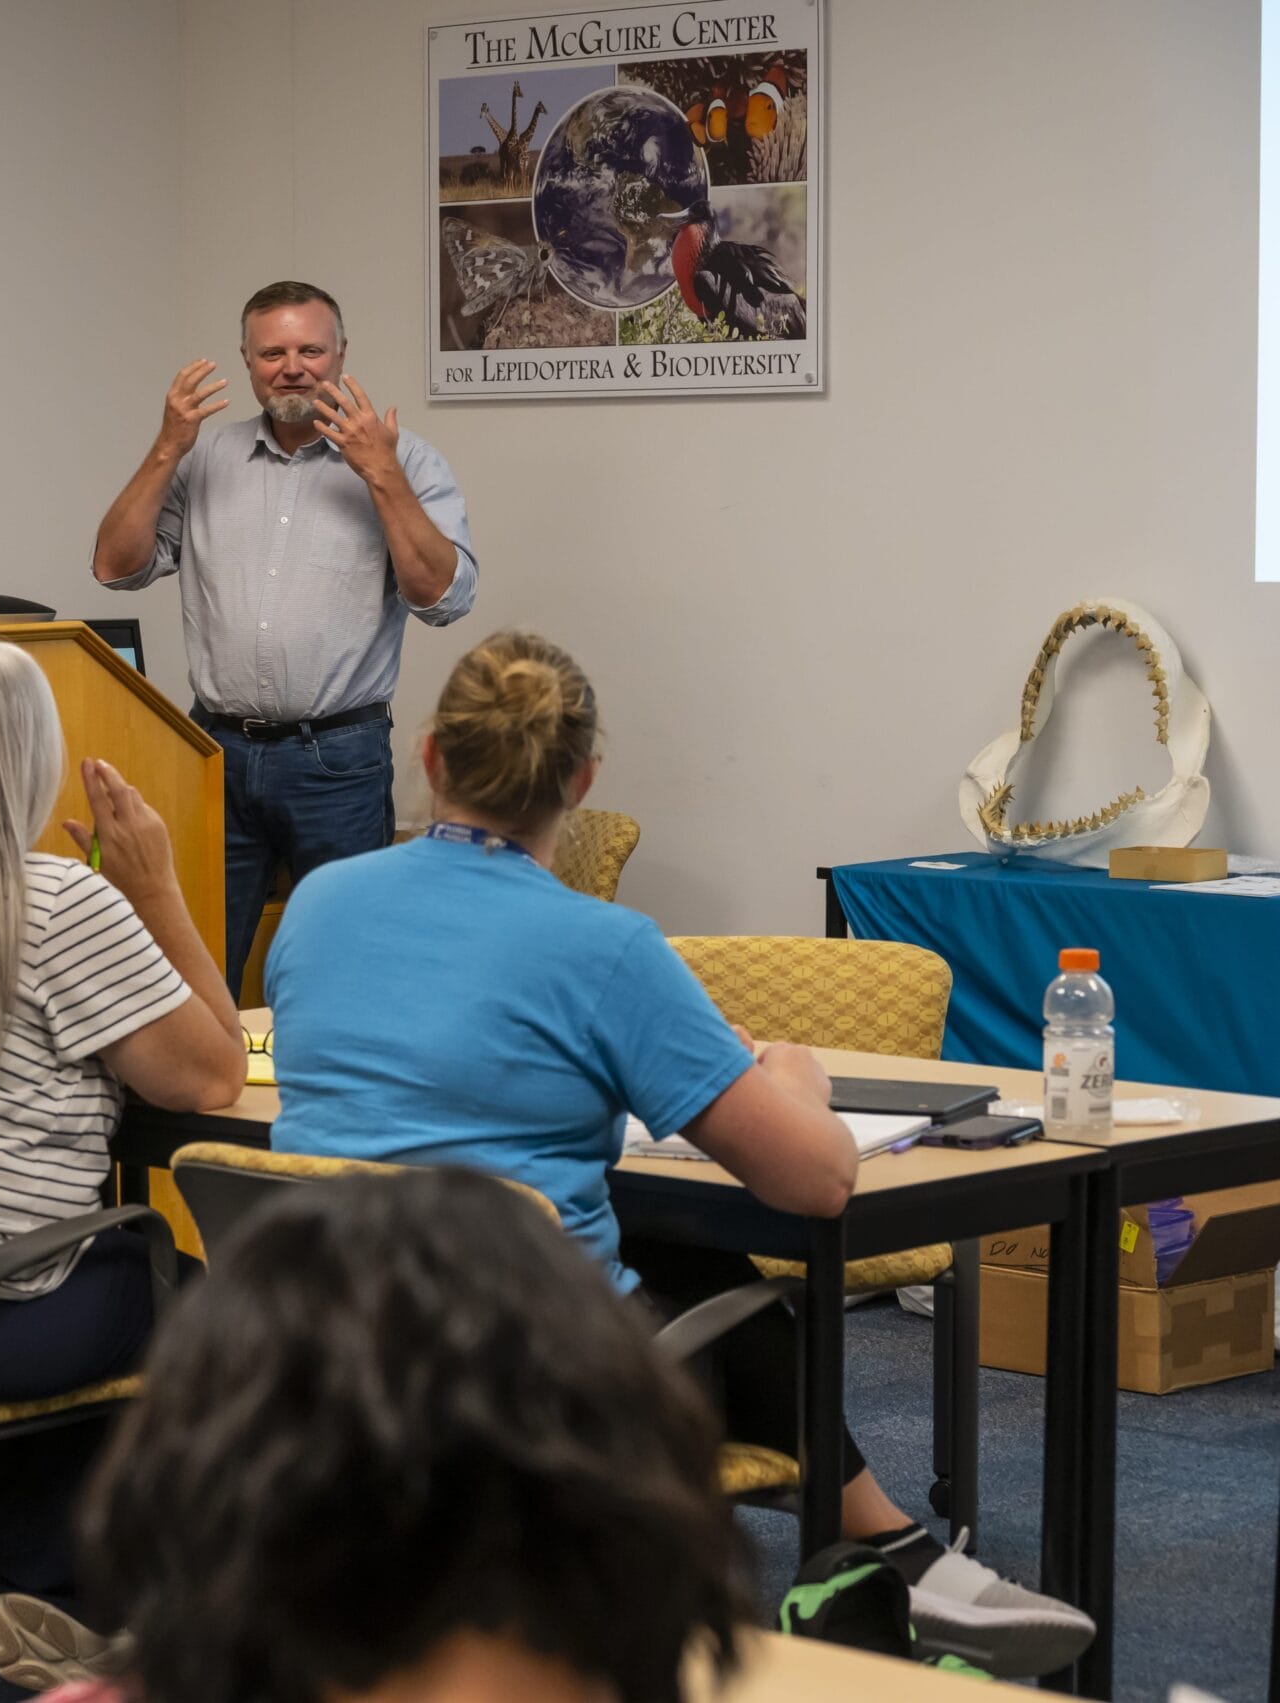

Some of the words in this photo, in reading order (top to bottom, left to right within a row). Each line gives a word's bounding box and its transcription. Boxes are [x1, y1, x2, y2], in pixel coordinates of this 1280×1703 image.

[672, 11, 778, 47] CENTER
[446, 367, 474, 383] FOR
[481, 355, 615, 382] LEPIDOPTERA
[623, 353, 643, 379] &
[650, 350, 801, 378] BIODIVERSITY
[1080, 1073, 1113, 1090] ZER
